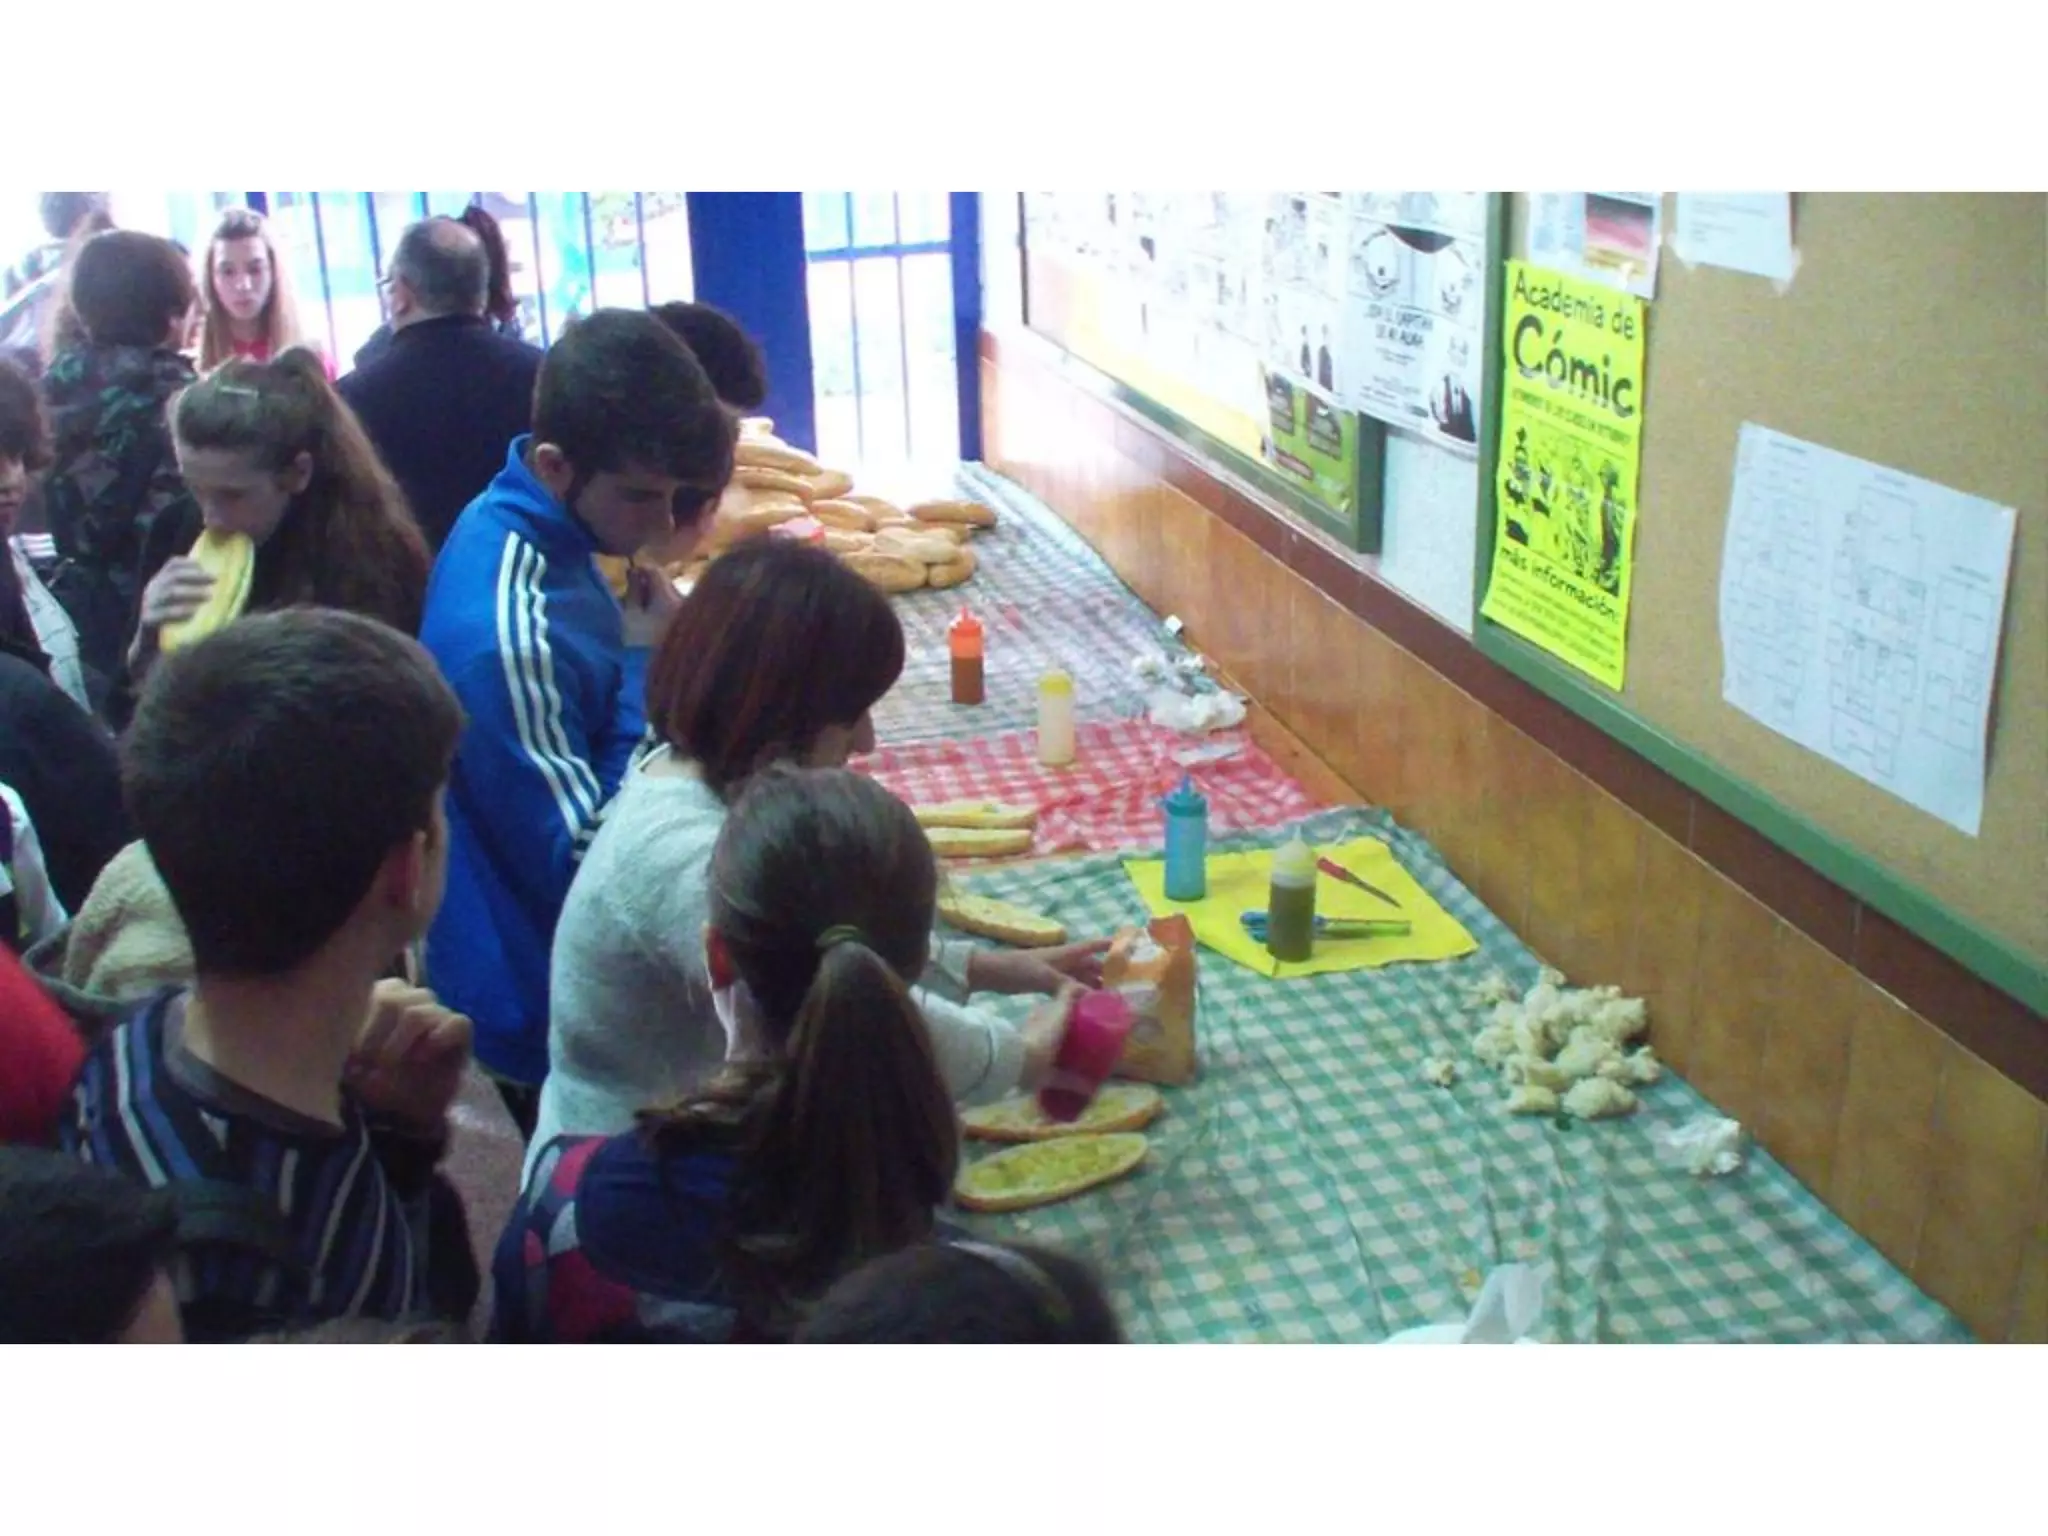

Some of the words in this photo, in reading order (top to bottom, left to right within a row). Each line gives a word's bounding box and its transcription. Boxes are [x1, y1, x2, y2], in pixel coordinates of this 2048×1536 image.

[1515, 268, 1604, 328] Academia
[1611, 301, 1634, 340] de
[1513, 314, 1634, 418] Cómic
